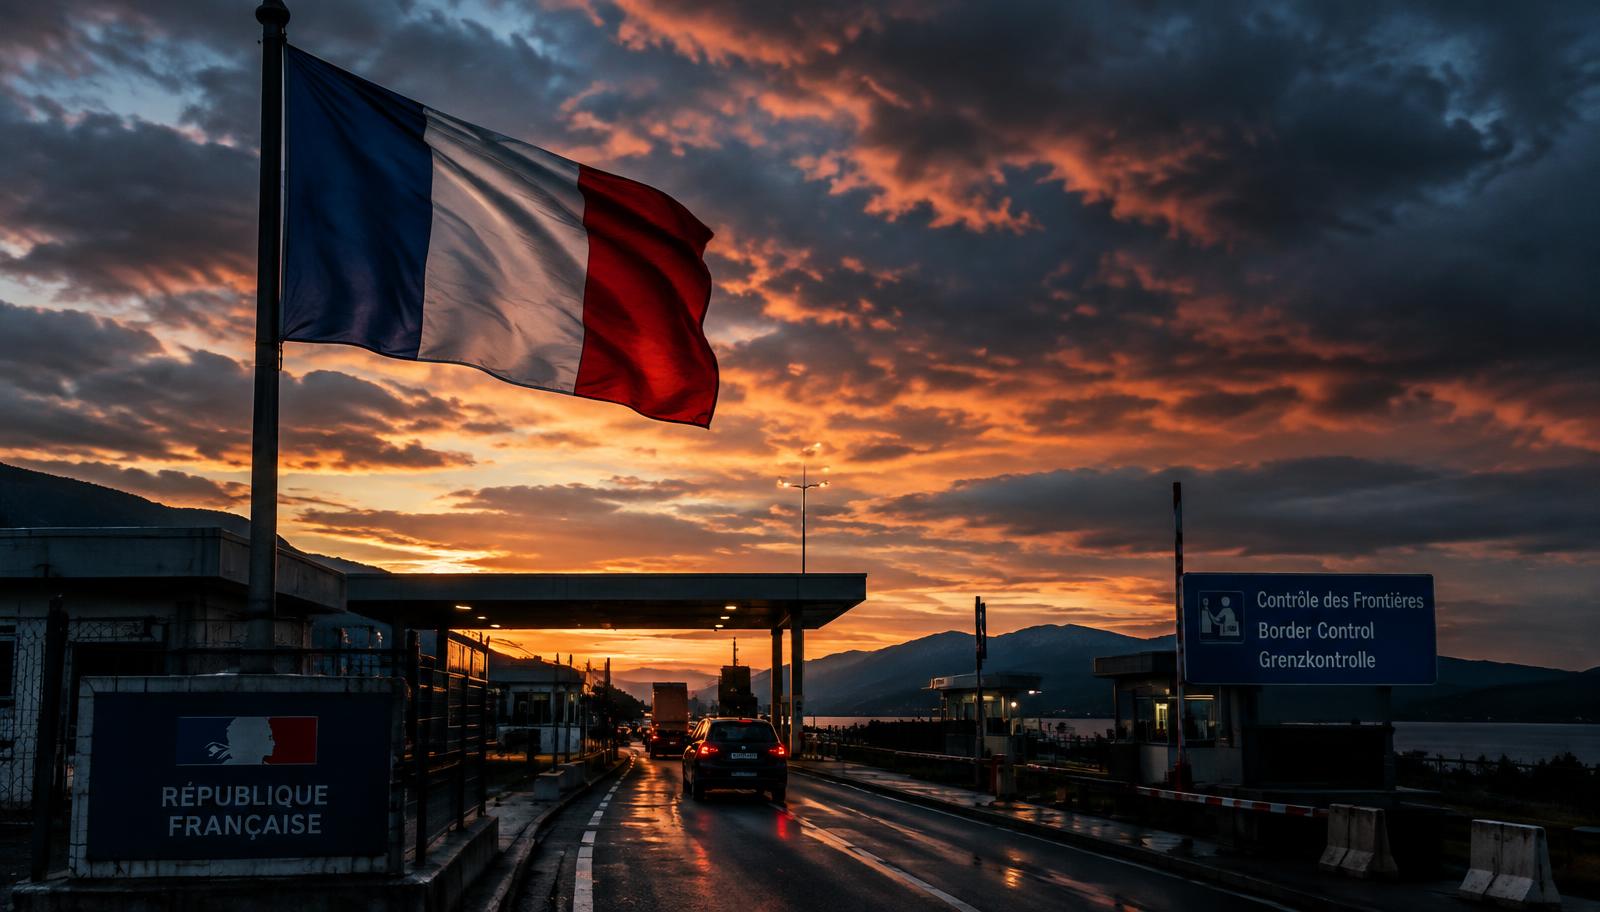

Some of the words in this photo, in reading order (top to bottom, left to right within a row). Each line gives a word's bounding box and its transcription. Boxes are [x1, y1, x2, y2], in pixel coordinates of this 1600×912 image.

[1257, 591, 1319, 609] Contrôle
[1323, 591, 1350, 609] des
[1258, 621, 1312, 639] Border
[1317, 621, 1375, 639] Control
[1259, 650, 1376, 668] Grenzkontrolle
[161, 781, 329, 808] RÉPUBLIQUE
[168, 814, 322, 840] FRANÇAISE
